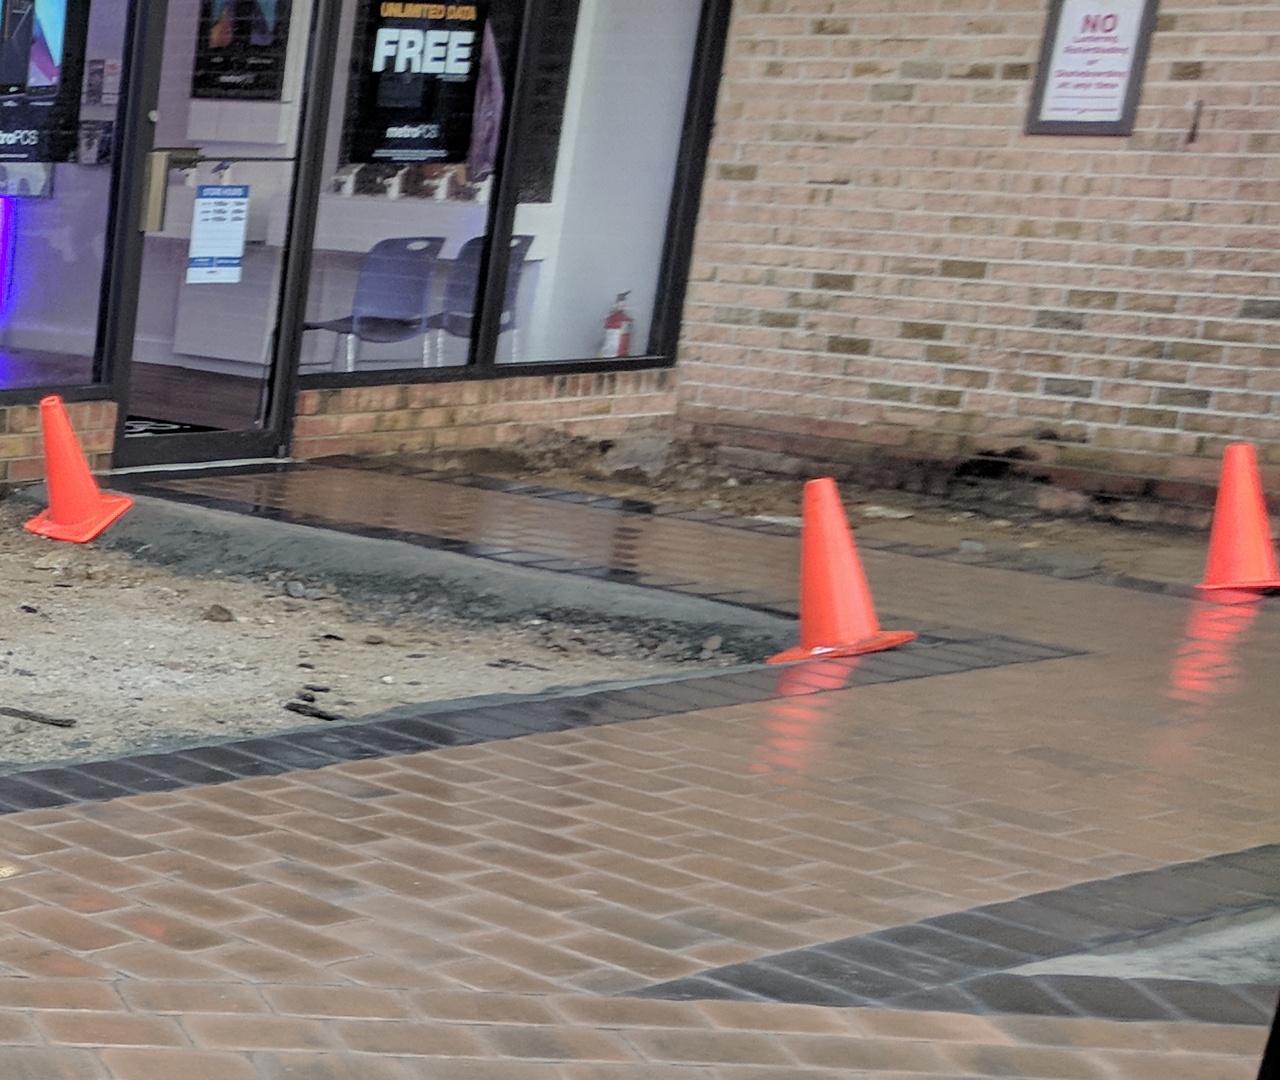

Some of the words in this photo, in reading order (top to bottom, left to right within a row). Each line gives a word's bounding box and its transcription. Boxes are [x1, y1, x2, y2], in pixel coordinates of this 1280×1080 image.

[380, 2, 446, 19] UNLIMITED
[446, 5, 477, 20] DATA
[1081, 14, 1118, 33] NO
[372, 28, 476, 74] FREE
